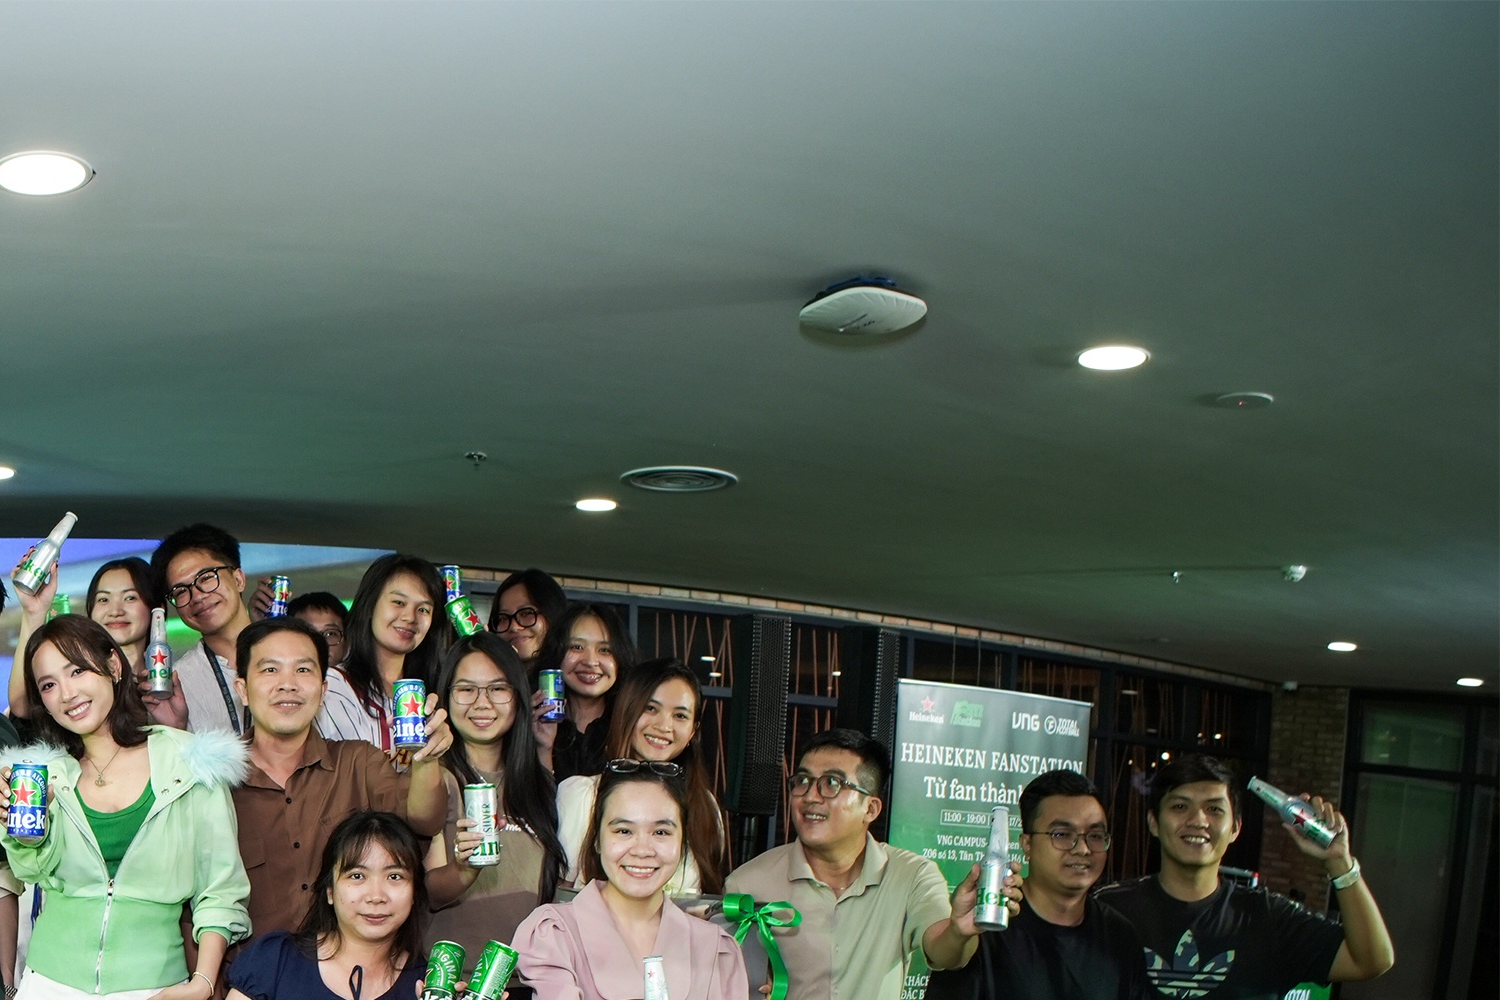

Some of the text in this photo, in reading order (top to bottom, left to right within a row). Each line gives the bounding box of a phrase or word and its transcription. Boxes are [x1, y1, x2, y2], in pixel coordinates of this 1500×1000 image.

[909, 711, 944, 724] Heineken
[901, 742, 986, 769] HEINEKEN
[924, 775, 947, 798] Từ
[950, 780, 976, 801] fan
[482, 803, 493, 833] SILVER
[943, 811, 961, 823] 11:00
[966, 813, 986, 825] 19:00
[937, 835, 953, 846] VNG
